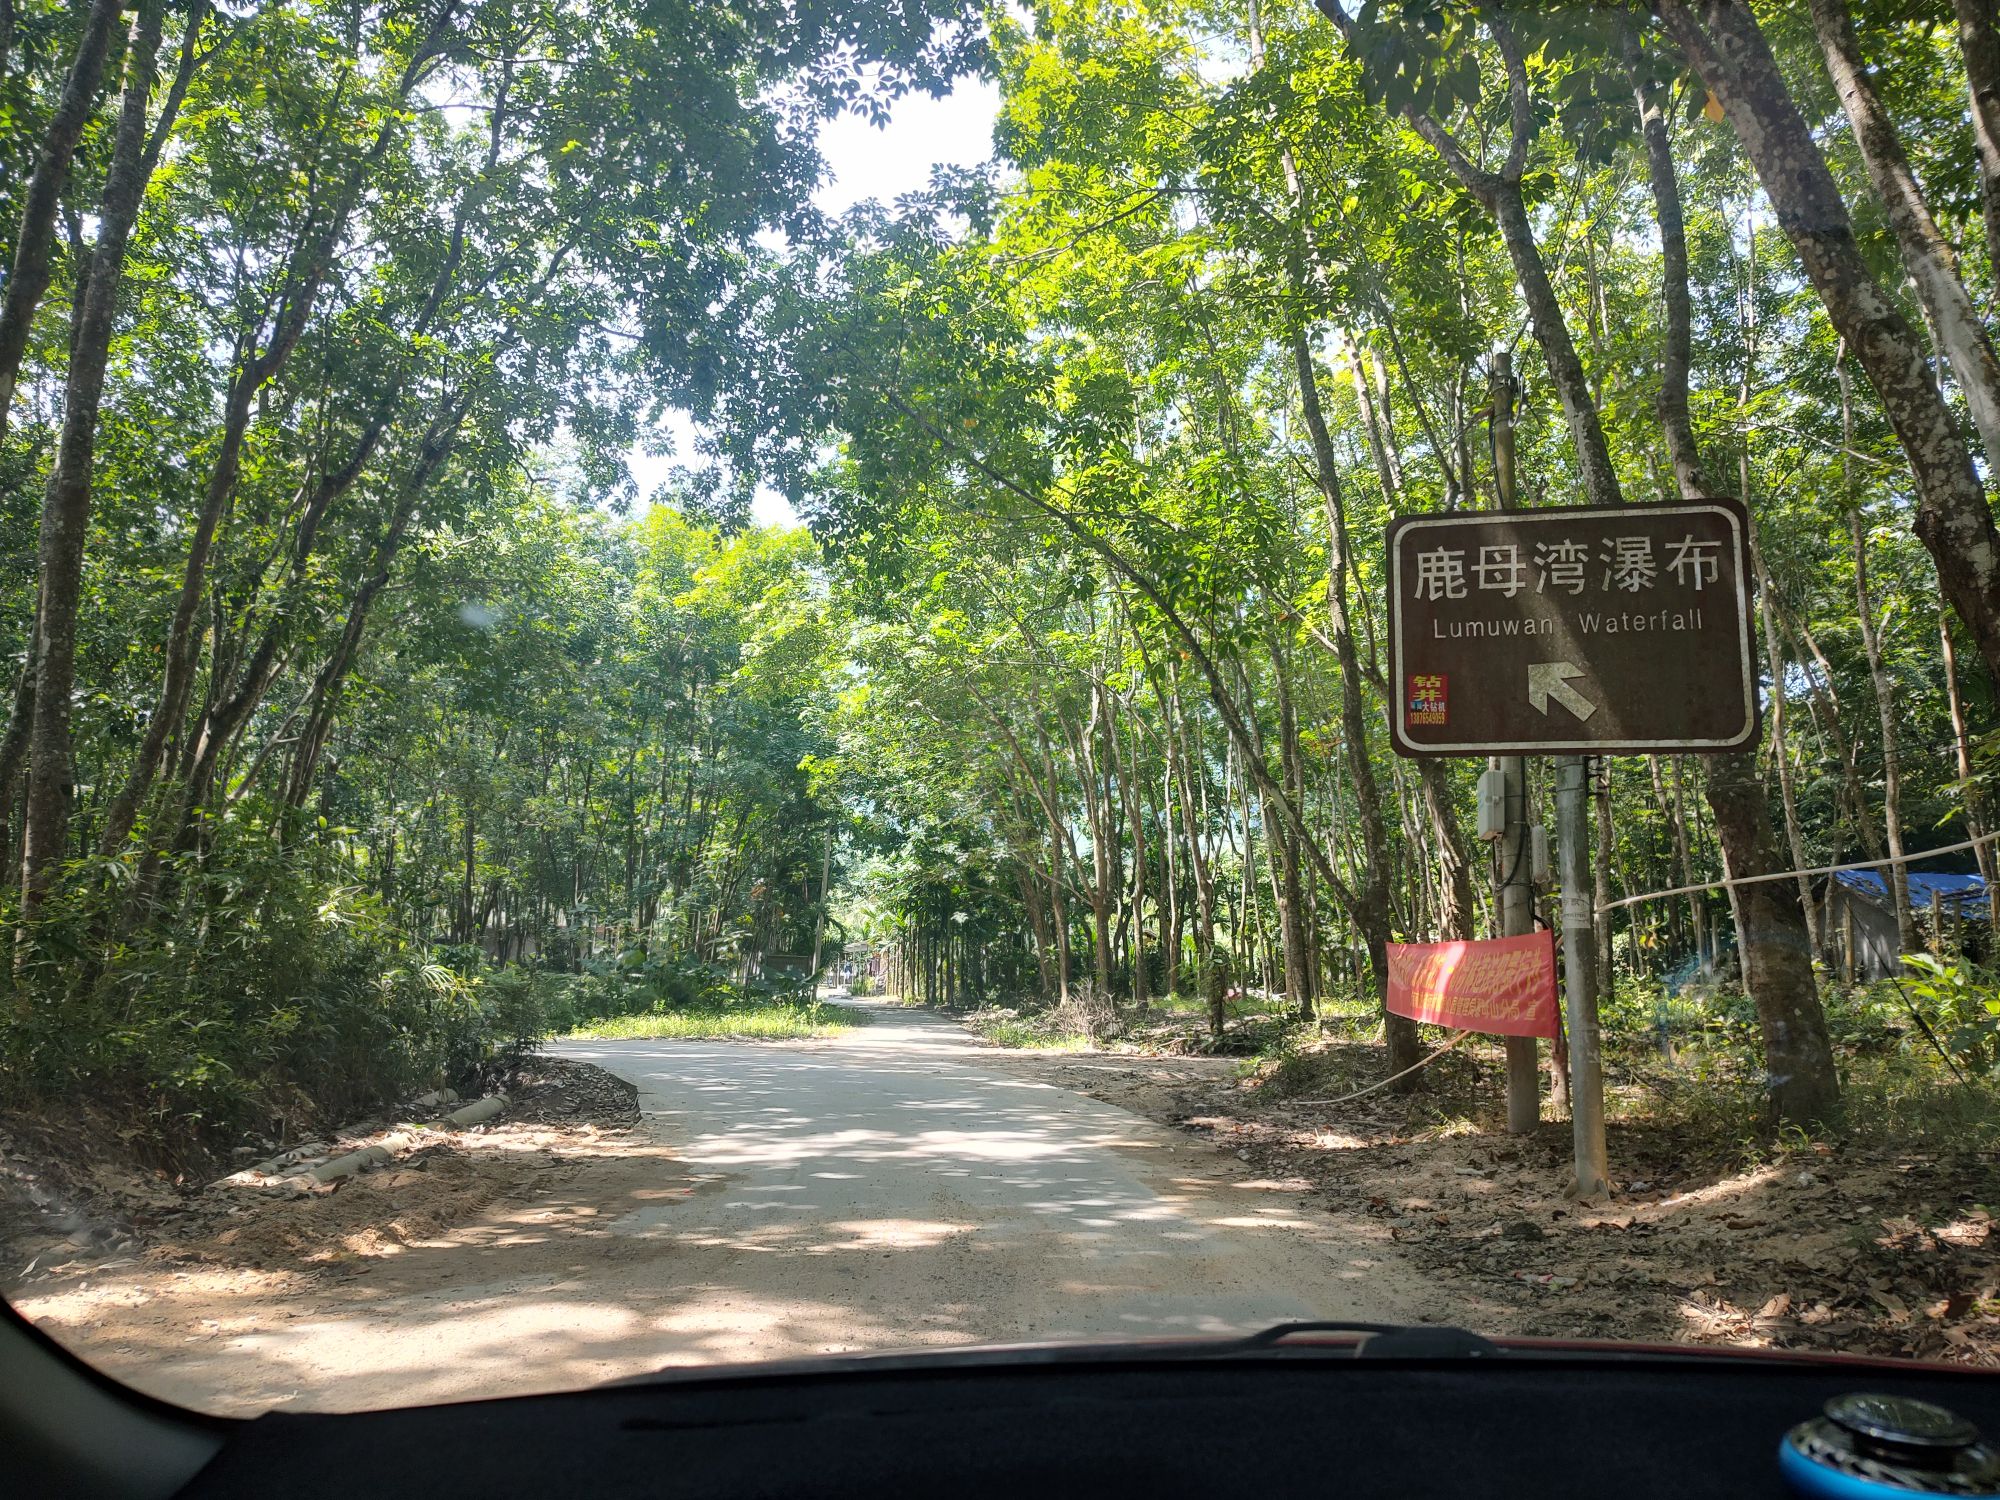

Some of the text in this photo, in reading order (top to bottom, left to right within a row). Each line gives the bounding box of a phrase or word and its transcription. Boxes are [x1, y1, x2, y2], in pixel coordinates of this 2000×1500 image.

[1414, 533, 1723, 601] 鹿母湾瀑布
[1434, 608, 1702, 639] Lumuwan Waterfall
